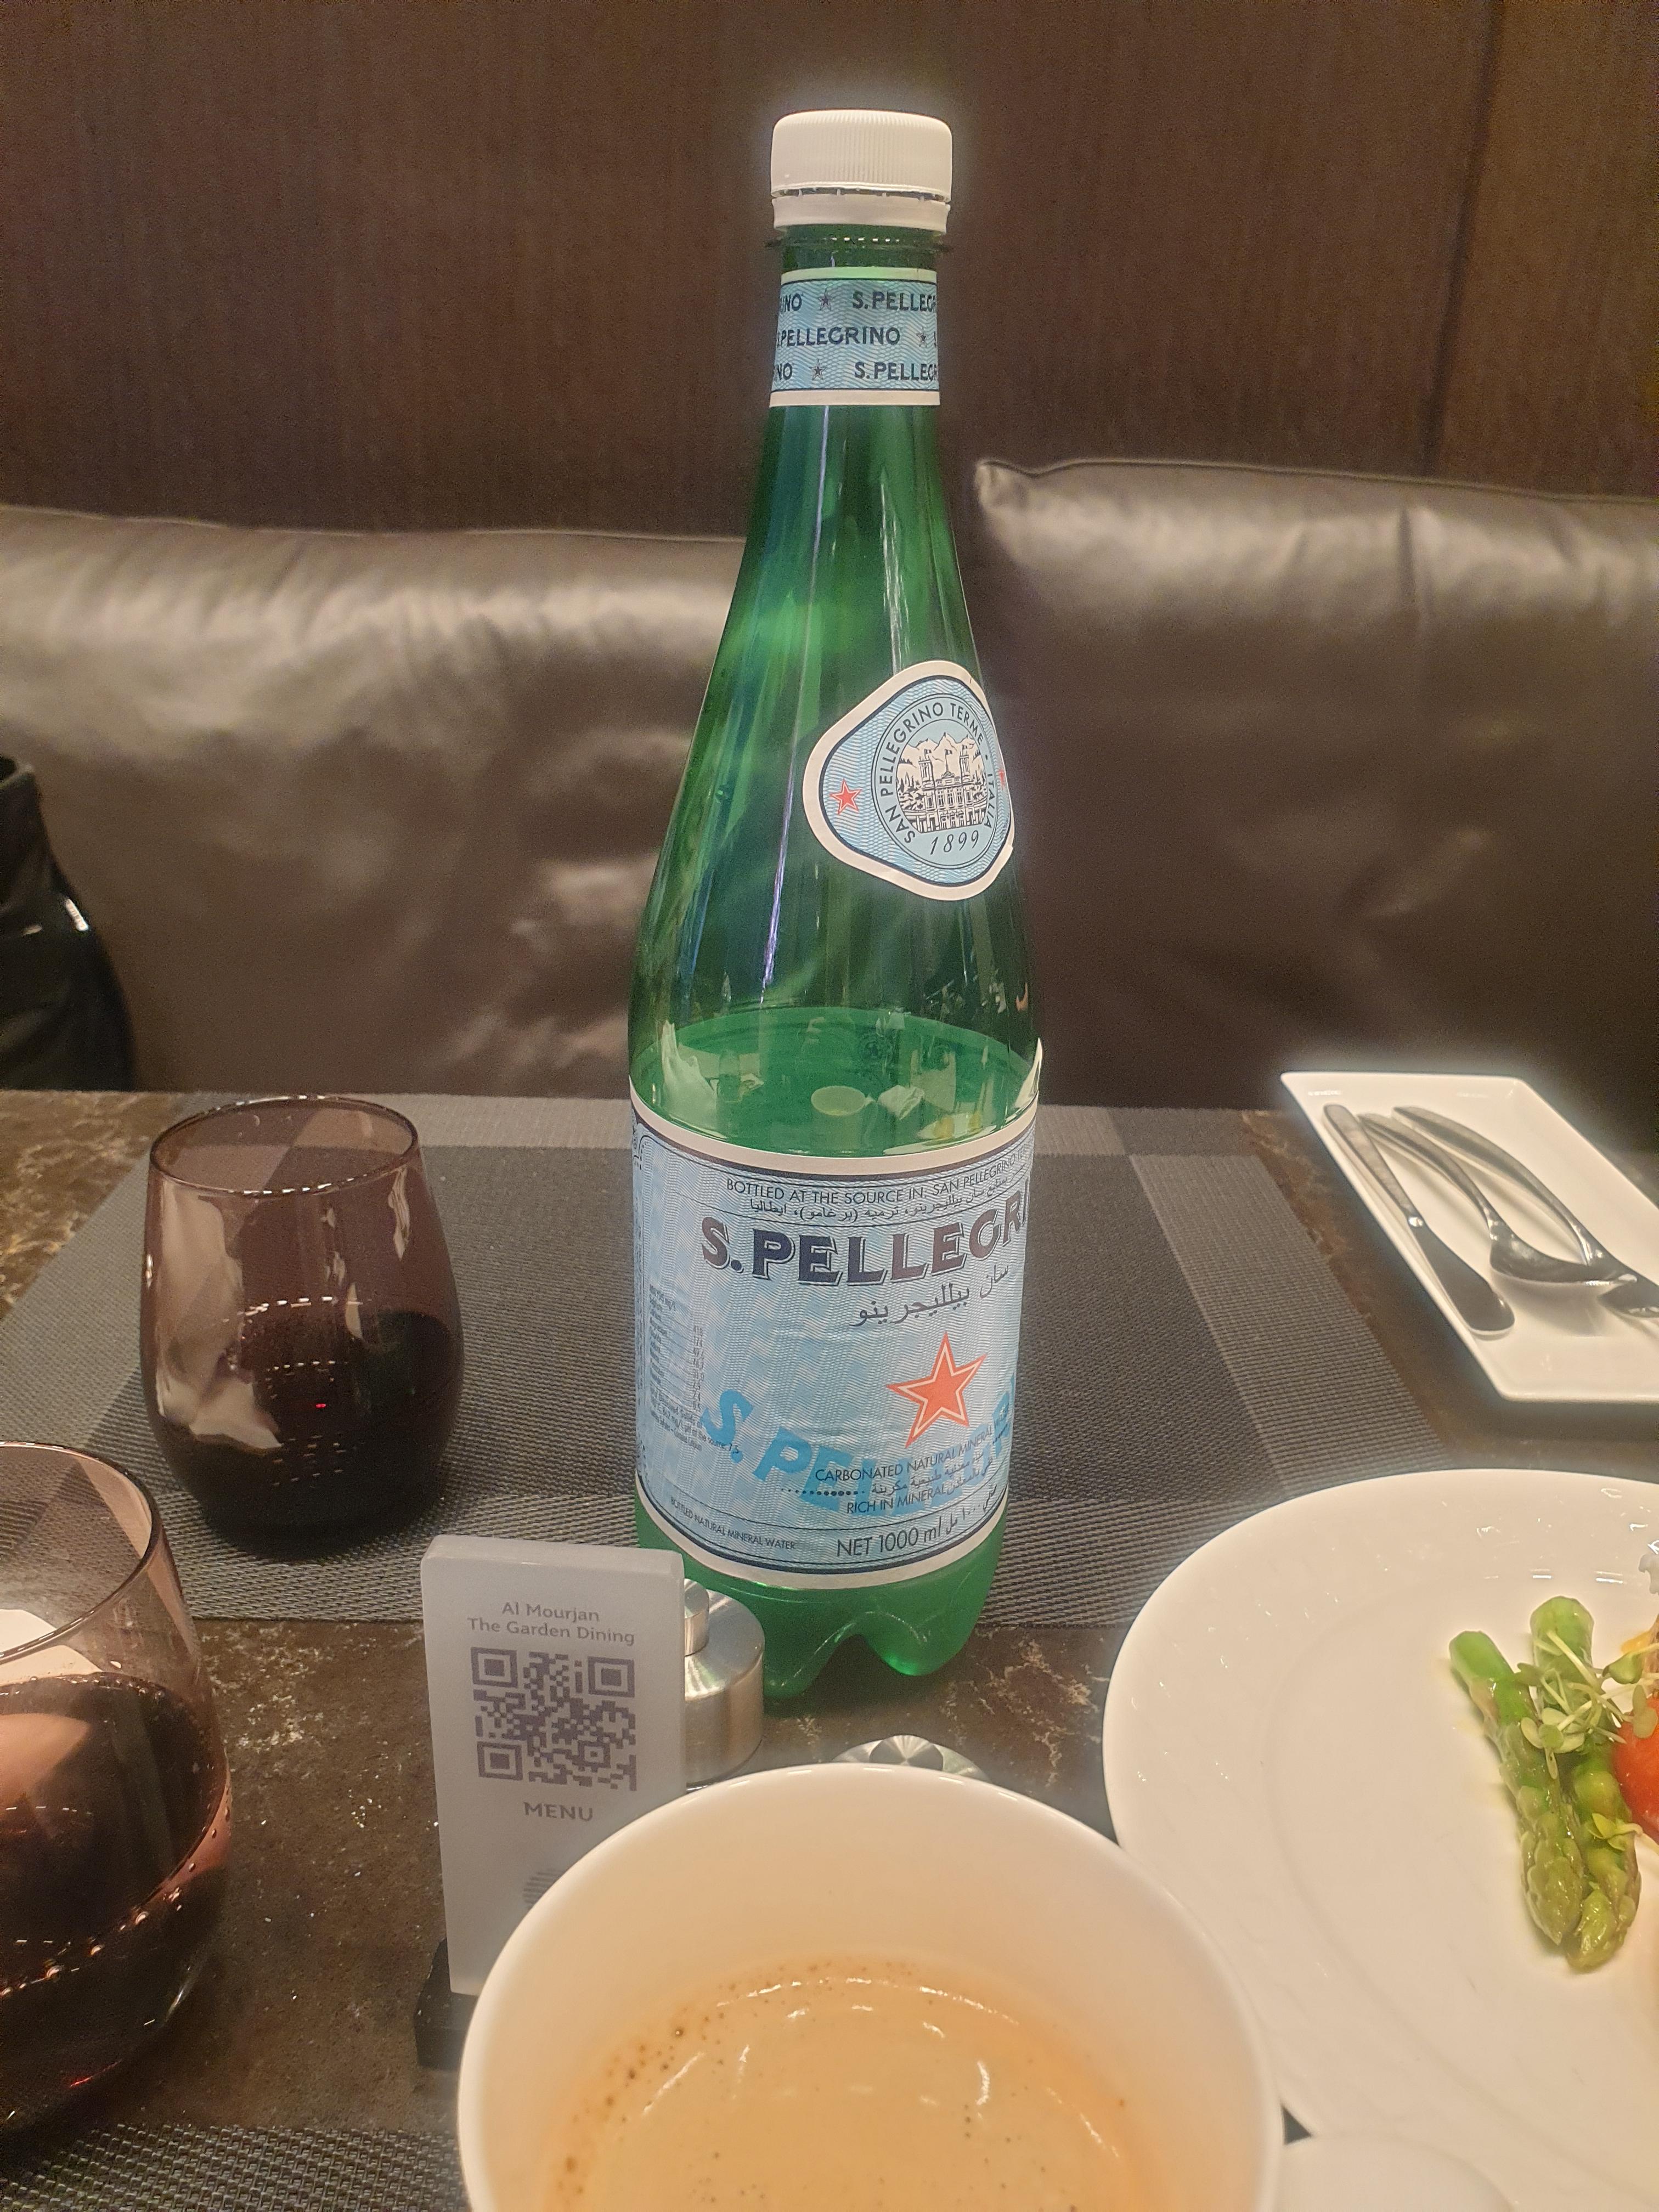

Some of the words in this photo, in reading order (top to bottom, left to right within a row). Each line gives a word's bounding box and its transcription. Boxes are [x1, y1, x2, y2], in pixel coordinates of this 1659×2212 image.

[950, 702, 984, 746] TERME
[879, 702, 944, 798] PELLEGRINO
[983, 774, 996, 829] ITALIA
[885, 806, 916, 844] SAN
[929, 830, 979, 855] 1899
[727, 1178, 785, 1199] BOTTLED
[789, 1189, 808, 1203] AT
[811, 1191, 838, 1204] THE
[844, 1189, 904, 1204] SOURCE
[933, 1179, 959, 1196] SAN
[963, 1153, 1015, 1189] PELLEGRINO
[815, 1464, 903, 1481] CARBONATED
[906, 1449, 956, 1473] NATURAL
[958, 1426, 992, 1456] MINERAL
[847, 1499, 876, 1514] RICH
[880, 1498, 894, 1510] IN
[896, 1483, 946, 1508] MINERAL
[695, 1515, 726, 1537] NATURAL
[727, 1528, 763, 1547] MINERAL
[765, 1537, 796, 1550] WATER
[837, 1536, 873, 1557] NET
[878, 1527, 919, 1554] 1000
[923, 1516, 942, 1542] ml
[501, 1601, 520, 1616] Al
[526, 1603, 600, 1622] Mourjan
[467, 1617, 500, 1633] The
[506, 1621, 571, 1639] Garden
[577, 1626, 635, 1646] Dining
[523, 1801, 593, 1822] MENU
